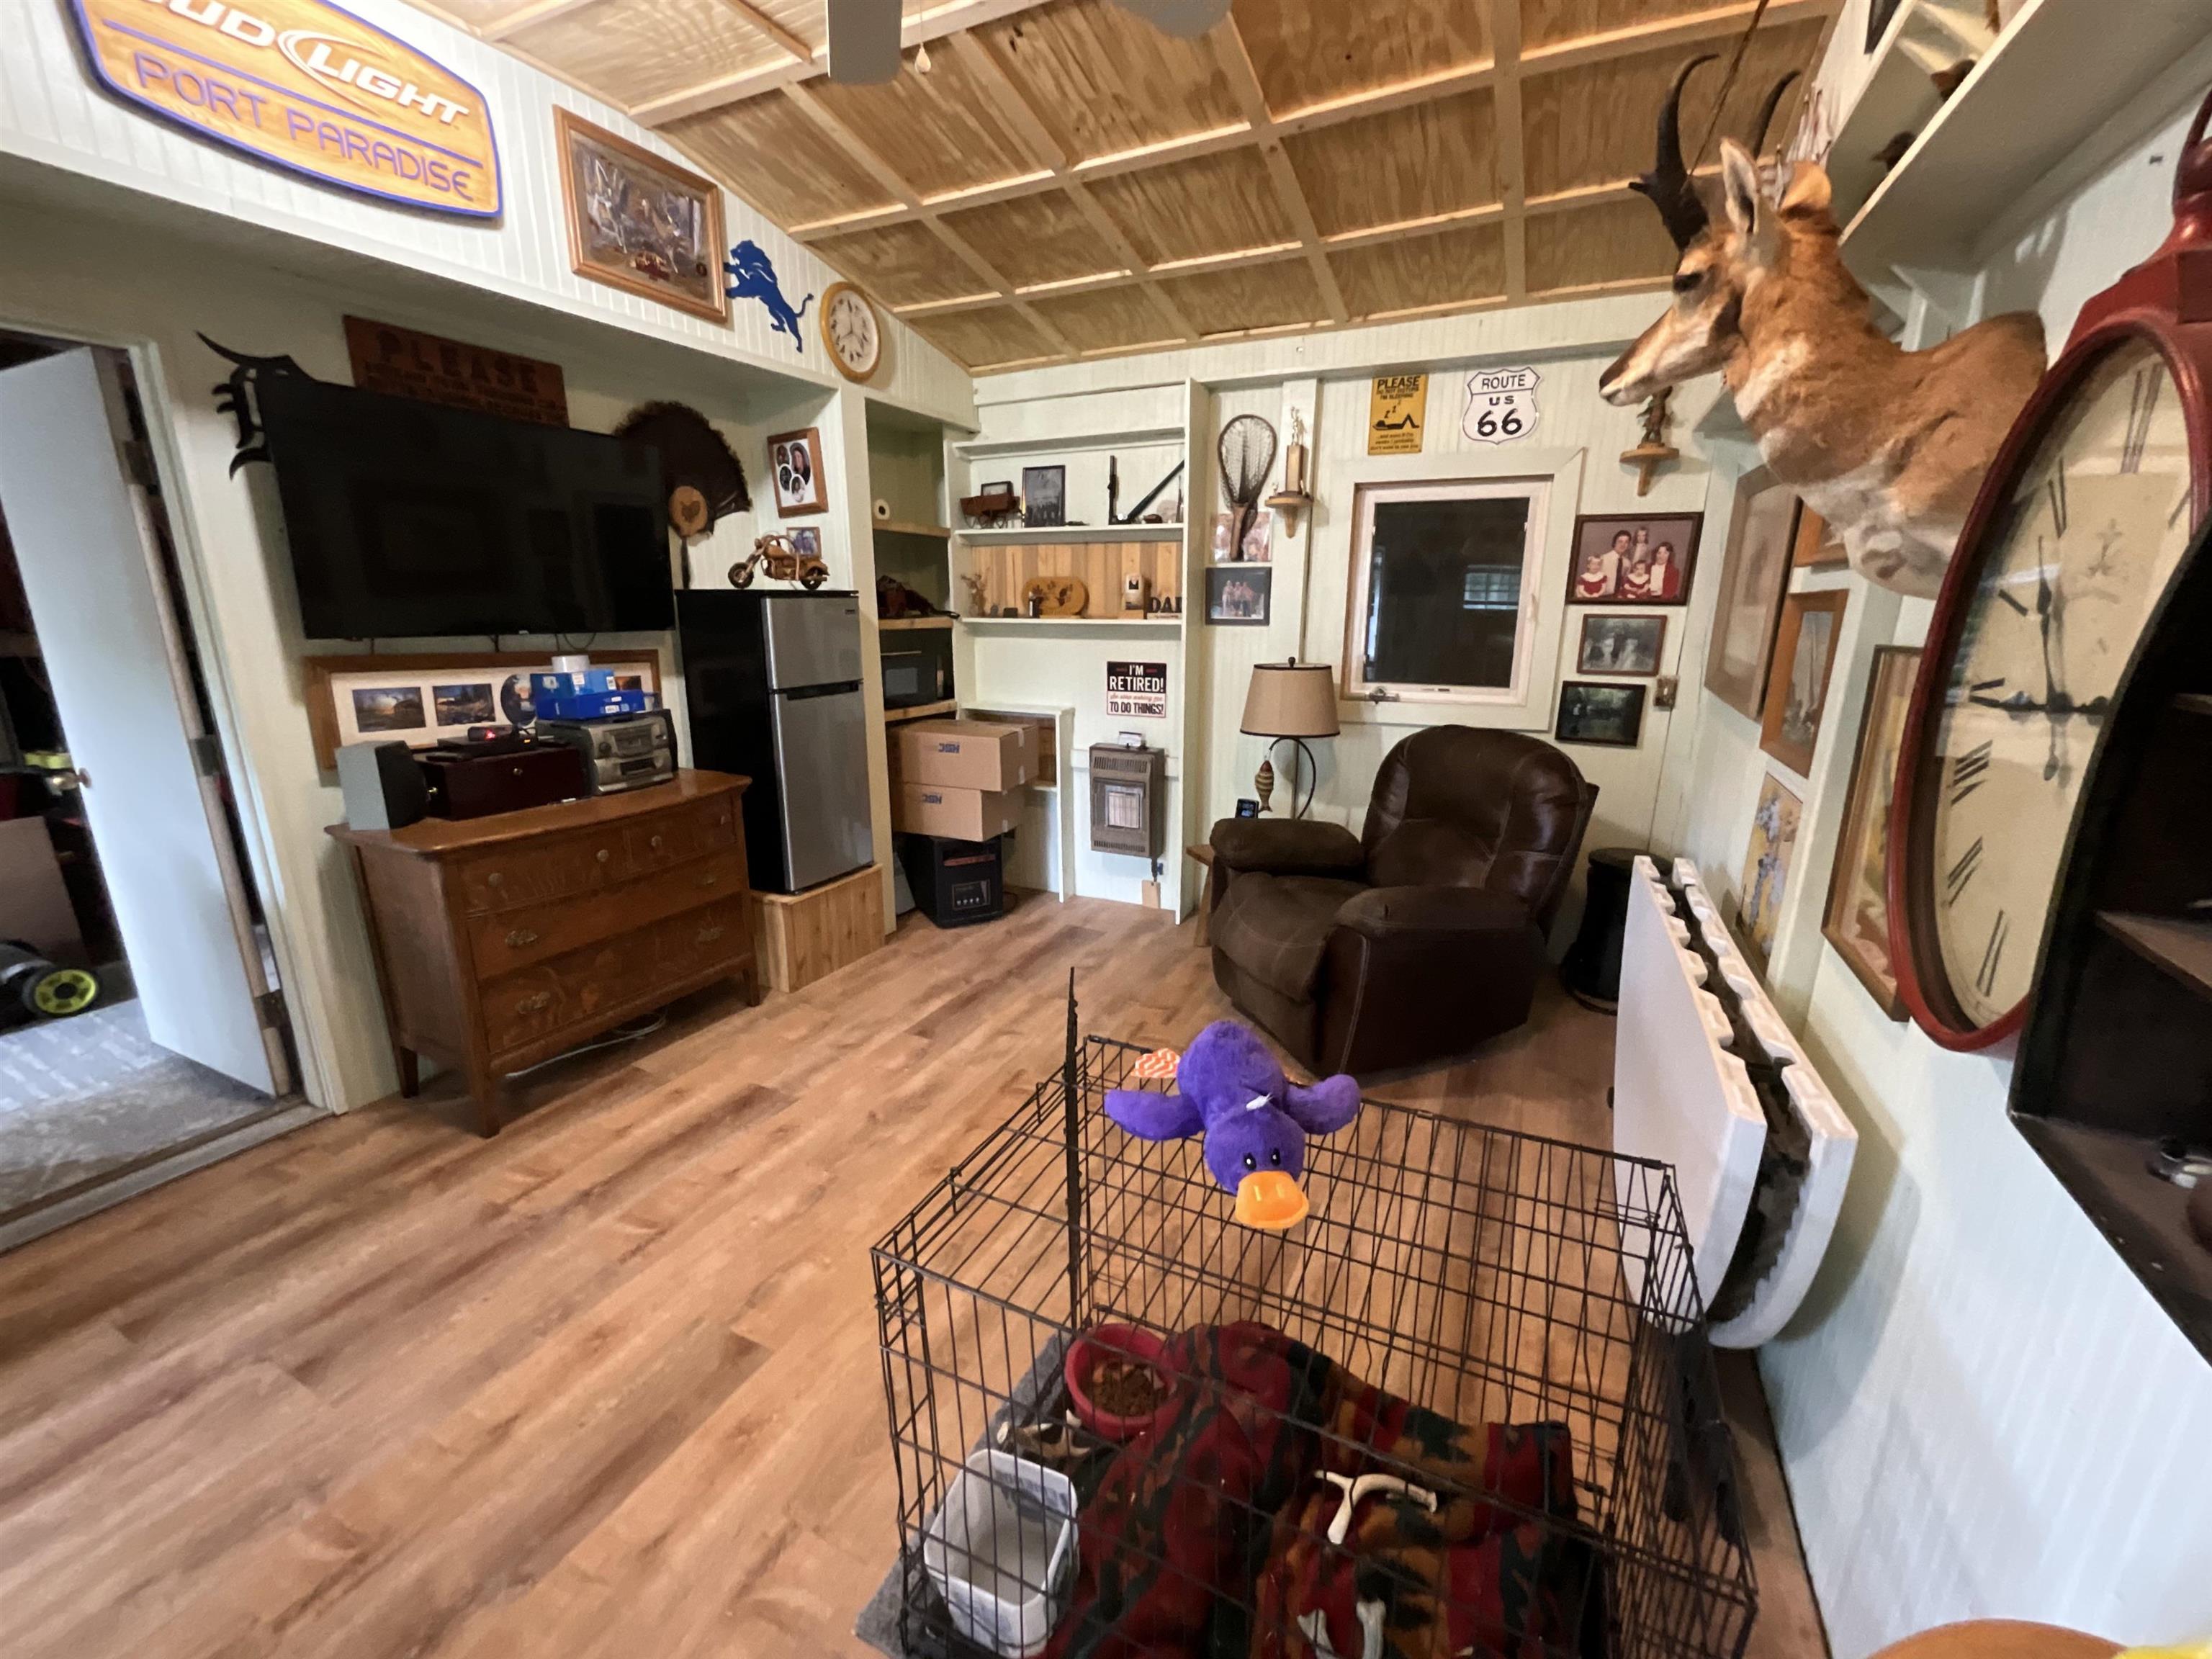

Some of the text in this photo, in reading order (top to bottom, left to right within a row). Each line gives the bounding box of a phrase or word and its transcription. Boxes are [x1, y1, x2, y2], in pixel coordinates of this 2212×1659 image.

[139, 0, 469, 125] UD LIGHT
[133, 50, 474, 202] PORT PARADISE
[1377, 375, 1421, 390] PLEASE
[1481, 374, 1526, 390] ROUTE
[1477, 408, 1523, 437] 66
[1129, 665, 1144, 675] I'M
[1109, 675, 1164, 693] RETIRED!
[1110, 701, 1164, 715] TO DO THINGS!
